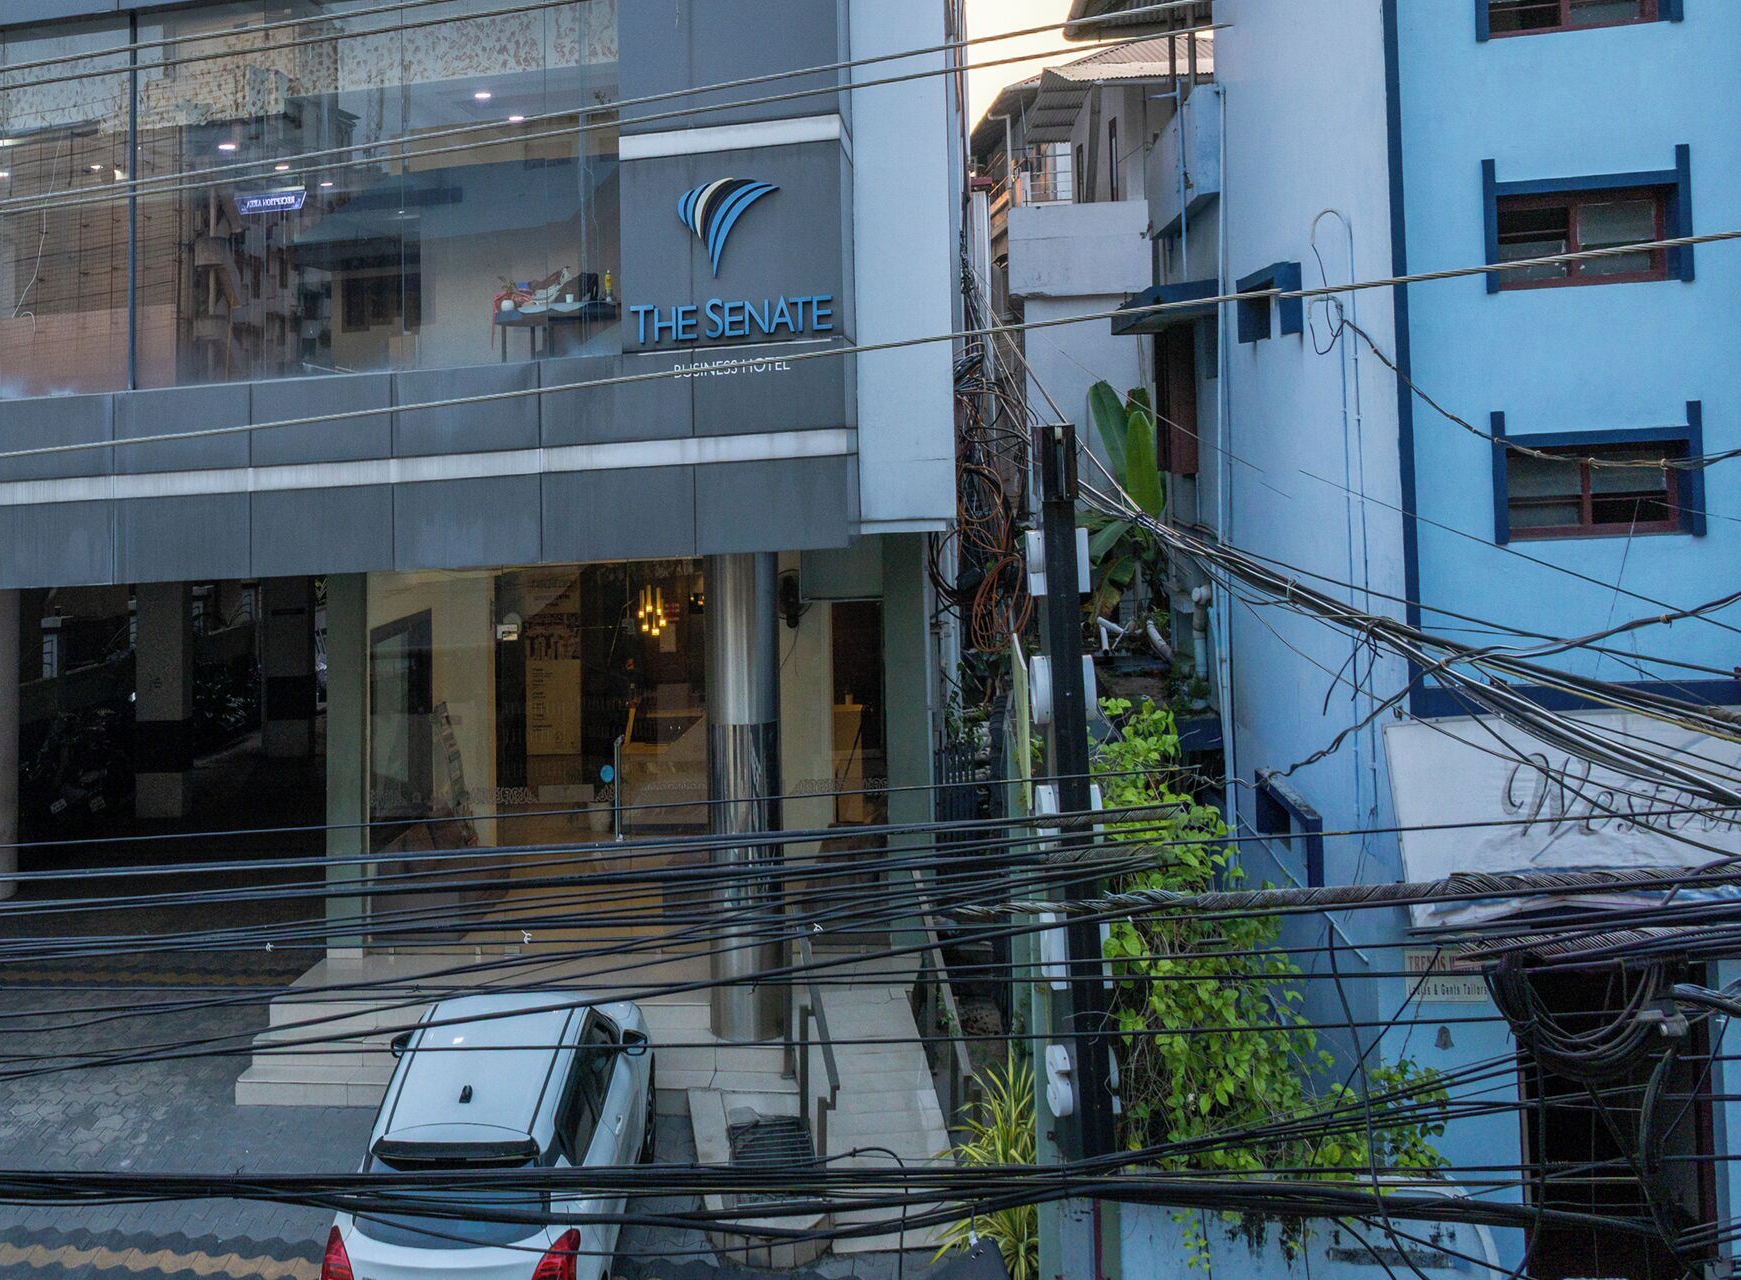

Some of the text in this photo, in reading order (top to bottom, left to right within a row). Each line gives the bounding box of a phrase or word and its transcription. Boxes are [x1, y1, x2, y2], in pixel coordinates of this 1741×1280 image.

[630, 295, 834, 344] THE SENATE
[1463, 983, 1487, 996] Tailors
